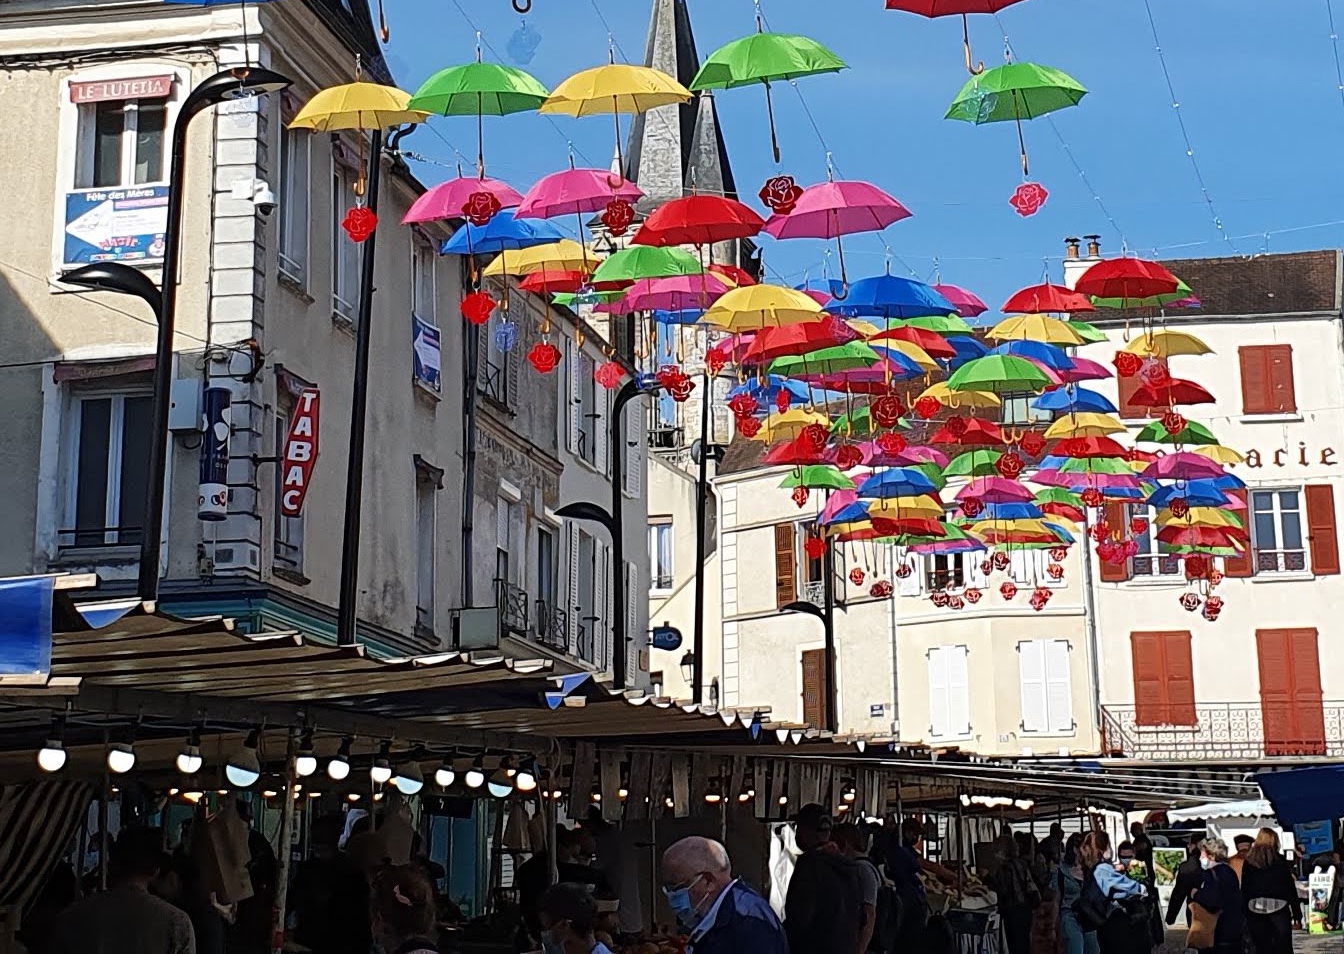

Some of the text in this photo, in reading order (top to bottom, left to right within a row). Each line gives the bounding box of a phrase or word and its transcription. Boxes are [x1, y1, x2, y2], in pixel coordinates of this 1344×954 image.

[77, 80, 164, 100] LE LUTETIA
[282, 392, 317, 511] TABAC
